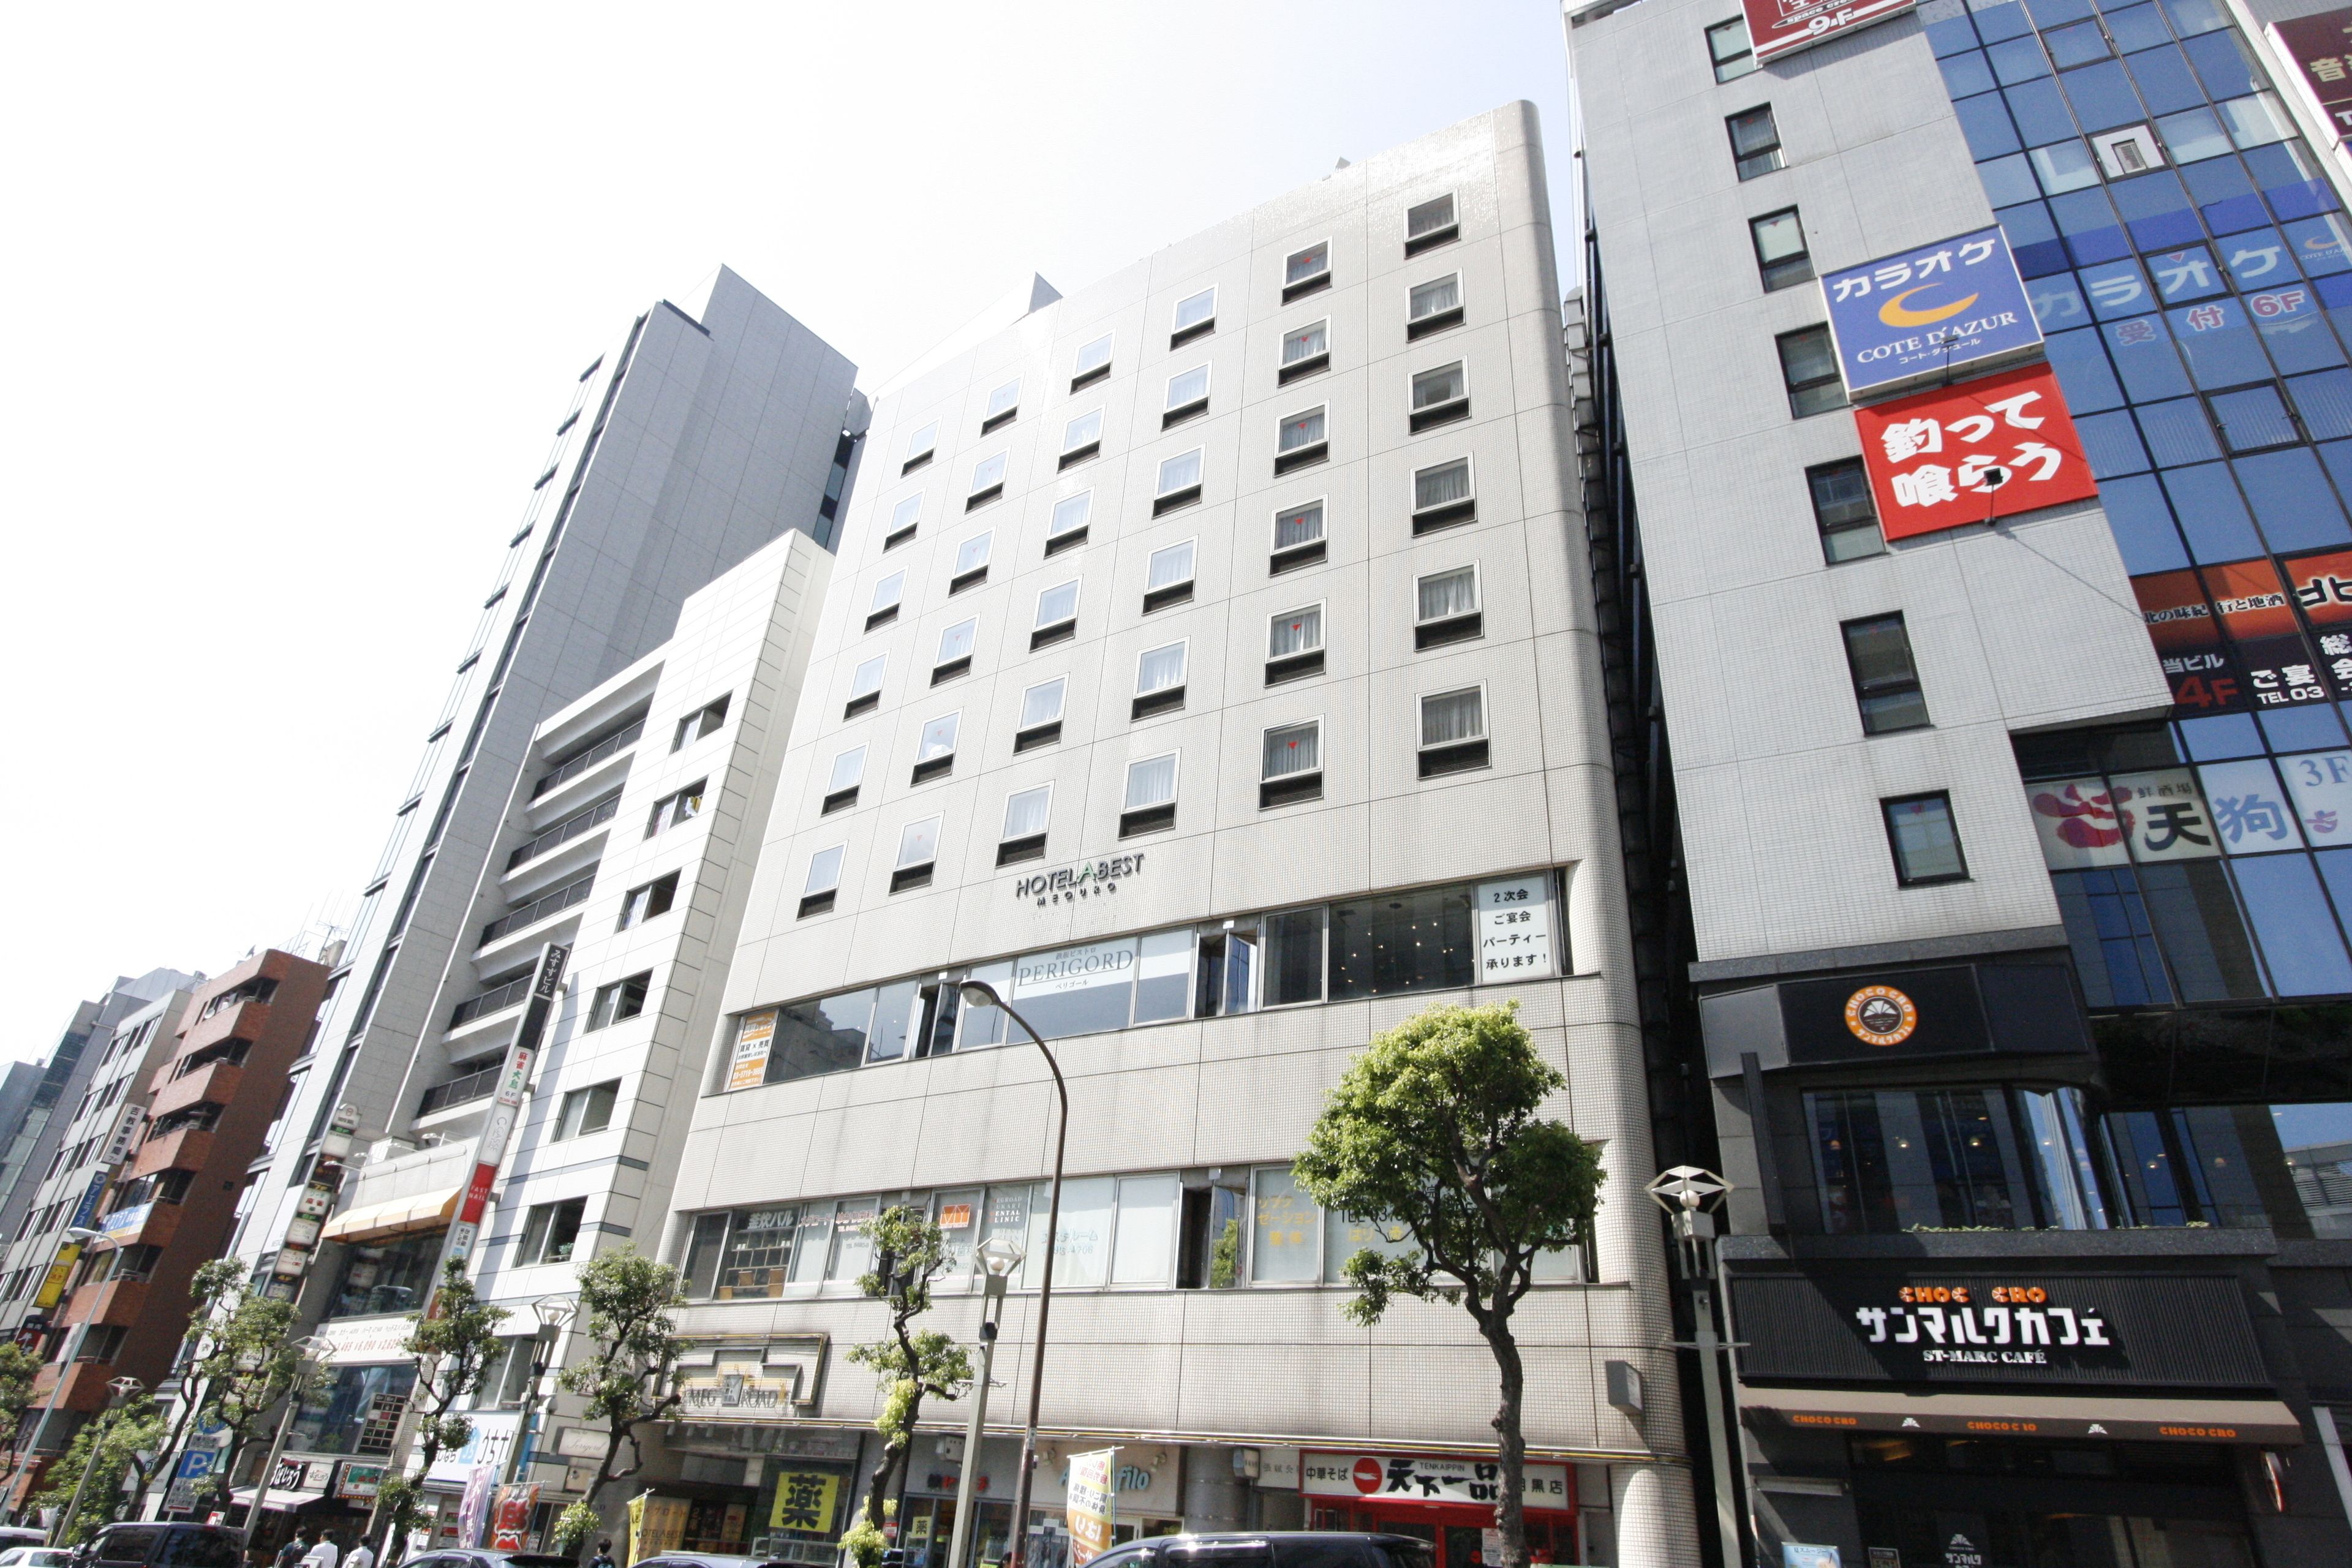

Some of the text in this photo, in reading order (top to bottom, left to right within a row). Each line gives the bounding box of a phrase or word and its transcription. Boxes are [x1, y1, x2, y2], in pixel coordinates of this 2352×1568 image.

[1833, 238, 1996, 303] カラオケ
[2032, 246, 2280, 321] カラオケ
[2116, 290, 2305, 346] 受付 6F
[1857, 337, 1921, 363] COTE
[1880, 391, 2046, 464] 釣って
[1891, 442, 2062, 507] 喰らう
[2163, 653, 2225, 674] 当ビル
[2175, 676, 2240, 708] 4F
[2257, 692, 2289, 704] TEL
[2299, 755, 2351, 787] 3F
[2144, 794, 2288, 852] 天狗
[1037, 882, 1117, 907] MEGURO
[1494, 888, 1528, 903] 2次会
[1494, 910, 1531, 925] ご宴会
[1483, 934, 1546, 948] パーティー
[1017, 950, 1133, 987] PERIGORD
[468, 1192, 486, 1202] NAIL
[470, 1185, 489, 1194] FAST
[1257, 1211, 1317, 1226] ゼーション
[1991, 1286, 2049, 1303] CRO
[1856, 1306, 2110, 1346] サンマルクカフェ
[1923, 1349, 2048, 1364] ST-MARC CAFÉ
[1792, 1415, 1831, 1424] CHOCO
[1967, 1421, 2009, 1431] CHOCO
[2159, 1426, 2206, 1437] CHOCO
[186, 1453, 207, 1476] P
[1305, 1466, 1349, 1480] 中華そば
[1419, 1461, 1465, 1472] TENKAIPPIN
[782, 1473, 827, 1529] 薬
